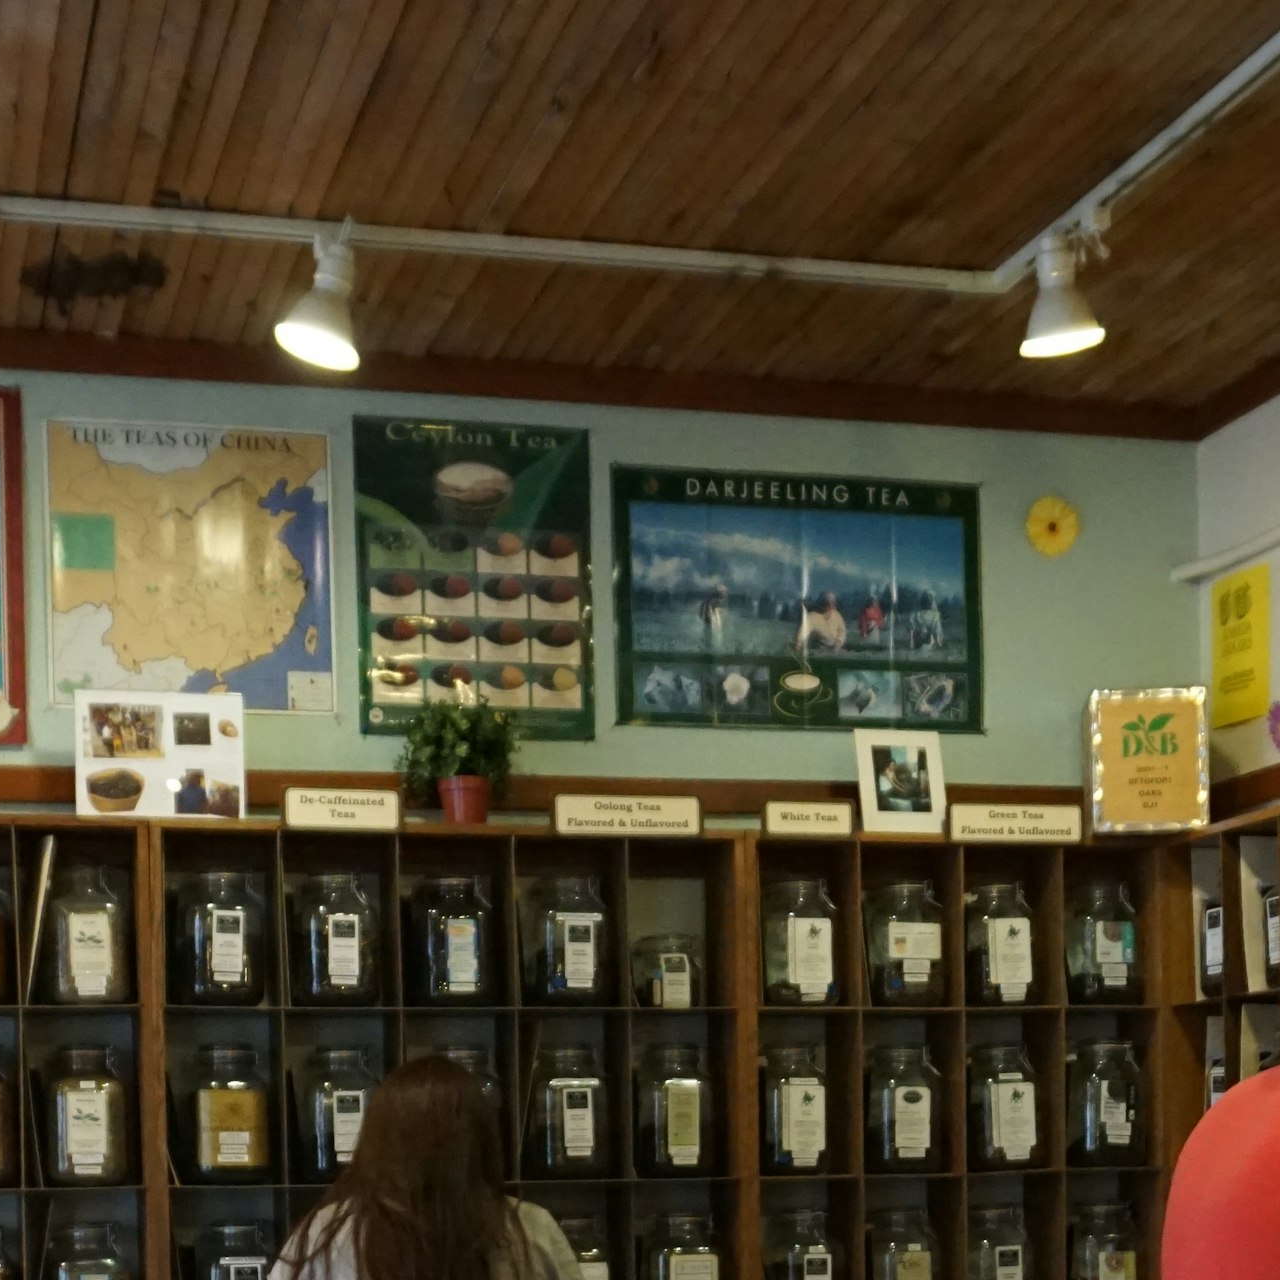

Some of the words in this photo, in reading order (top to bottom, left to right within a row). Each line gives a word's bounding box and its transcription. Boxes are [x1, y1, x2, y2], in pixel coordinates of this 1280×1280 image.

[72, 427, 114, 446] THE
[121, 428, 177, 448] TEAS
[183, 430, 213, 449] OF
[220, 432, 294, 454] CHINA
[385, 422, 493, 447] Ceylon
[503, 428, 557, 448] Tea
[685, 478, 850, 503] DARJEELING
[865, 486, 910, 507] TEA
[299, 795, 385, 806] De-Caffeinated
[594, 801, 633, 813] Oolong
[636, 802, 662, 811] Teas
[329, 809, 356, 818] Teas
[780, 811, 811, 822] White
[814, 812, 839, 822] Teas
[988, 809, 1019, 820] Green
[1021, 810, 1044, 820] Teas
[567, 817, 615, 827] Flavored
[618, 818, 627, 827] &
[630, 818, 689, 828] Unflavored
[960, 826, 1005, 836] Flavored
[1007, 826, 1016, 836] &
[1018, 825, 1072, 836] Unflavored
